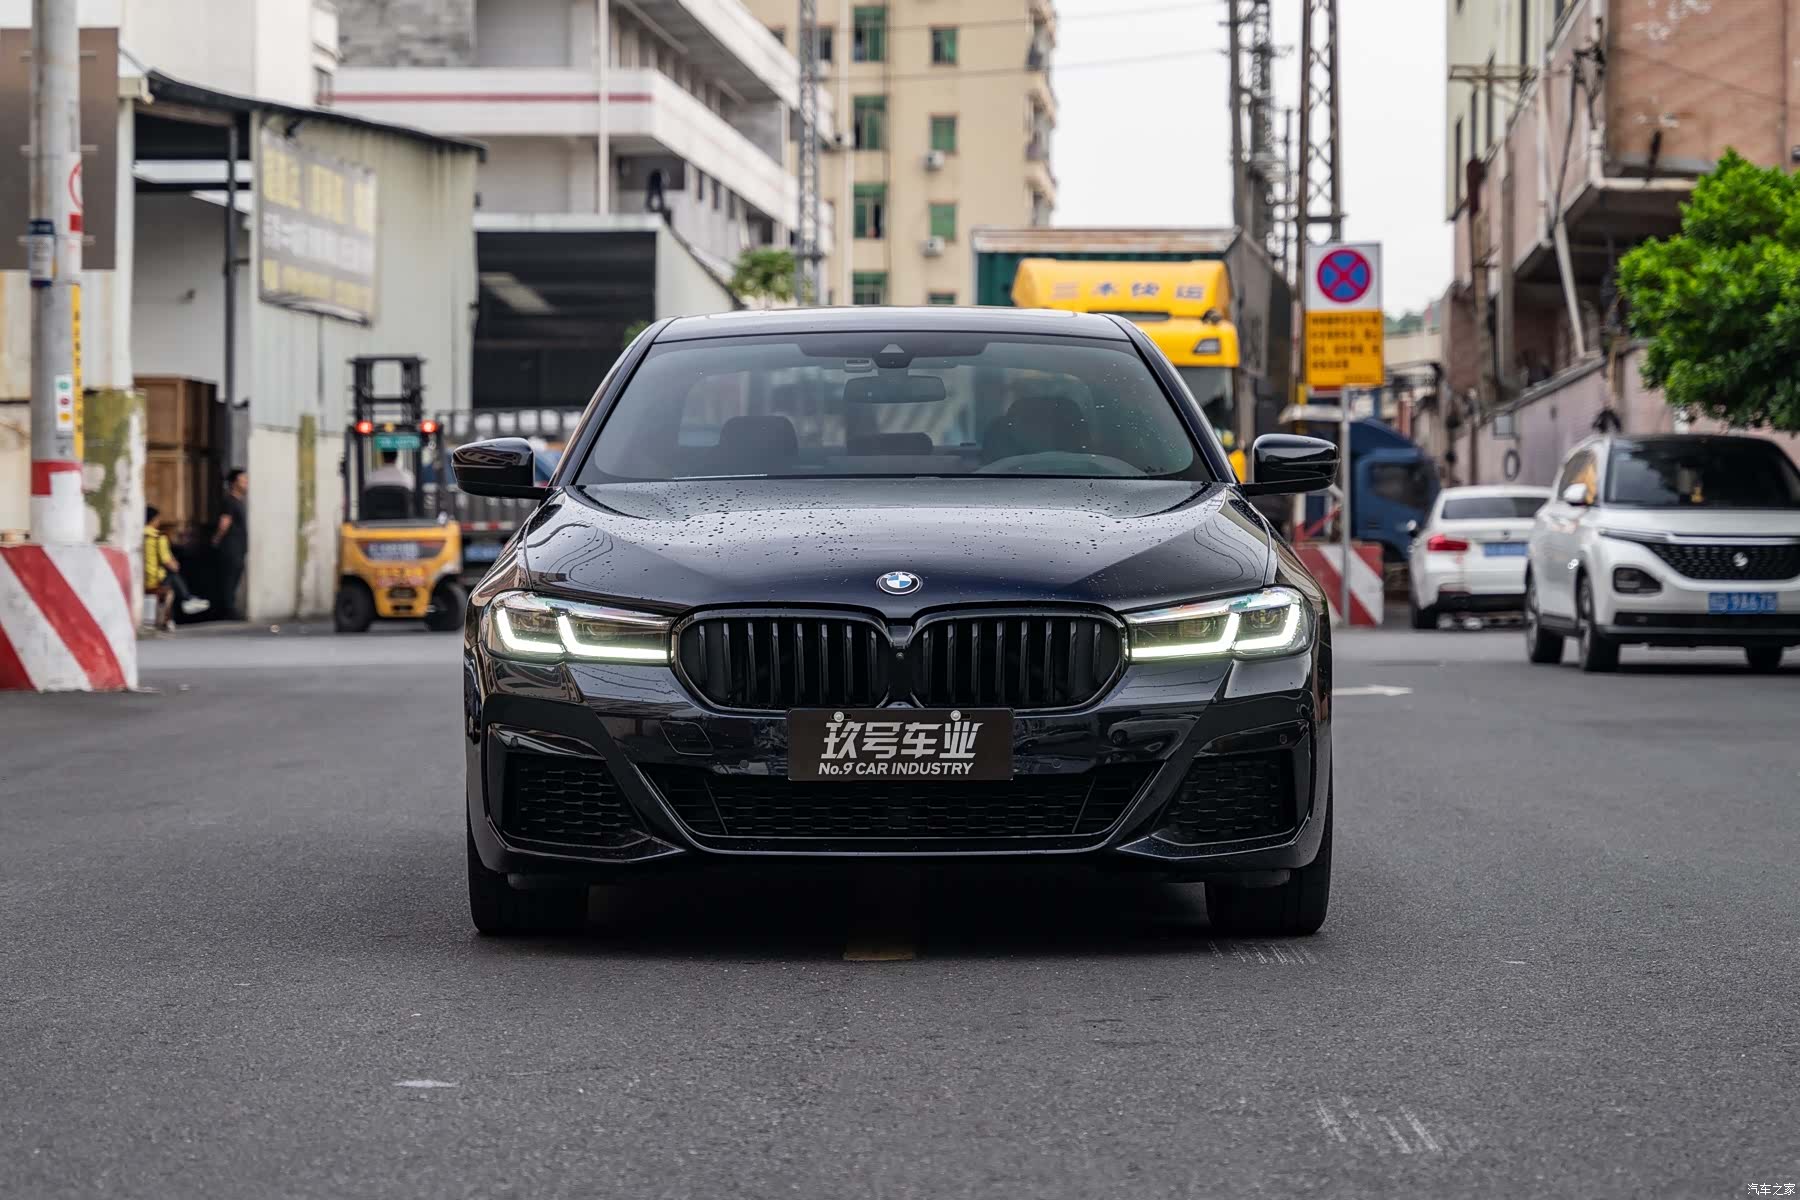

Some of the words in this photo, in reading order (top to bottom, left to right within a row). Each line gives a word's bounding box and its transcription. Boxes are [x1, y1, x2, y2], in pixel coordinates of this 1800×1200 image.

[820, 720, 984, 759] 玖号车业
[818, 762, 855, 775] No.9
[855, 762, 889, 775] CAR
[891, 762, 974, 775] INDUSTRY
